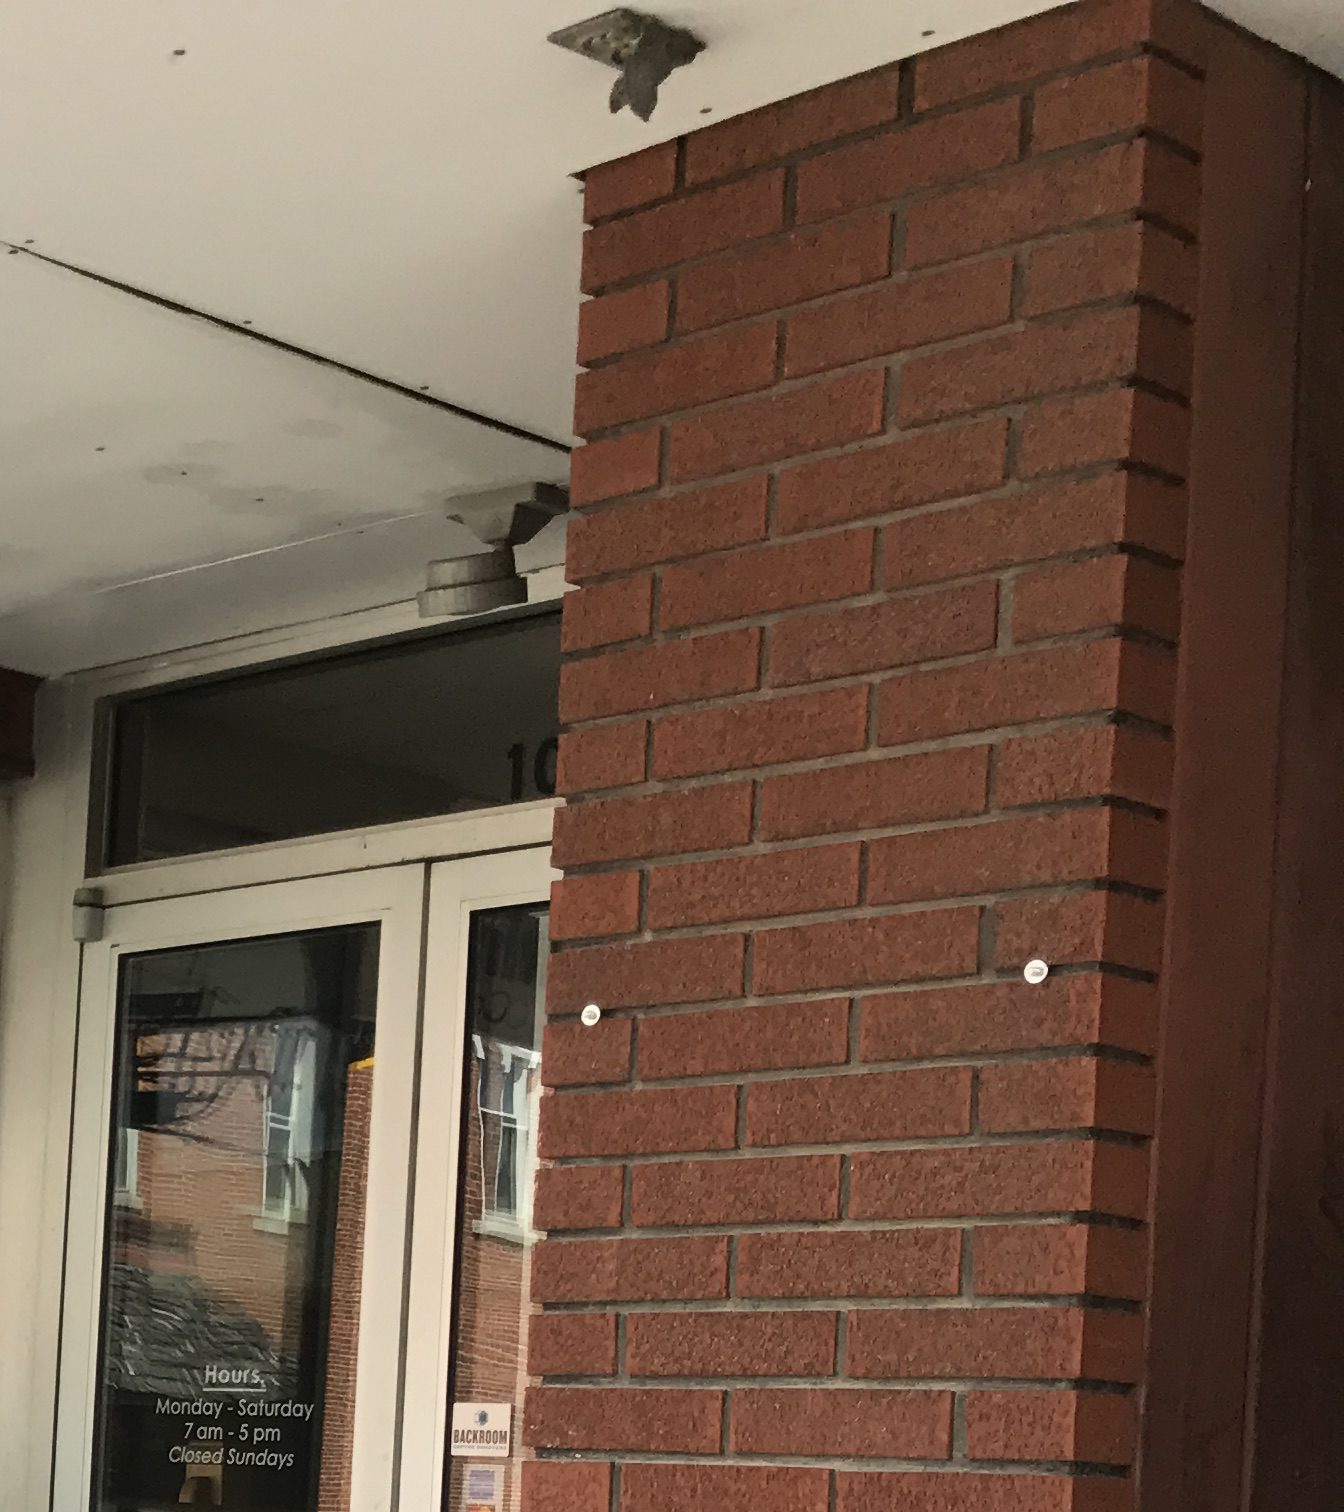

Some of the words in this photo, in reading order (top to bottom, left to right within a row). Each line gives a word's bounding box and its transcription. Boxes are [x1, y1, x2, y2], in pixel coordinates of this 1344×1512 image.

[155, 1398, 223, 1419] Monday
[238, 1399, 314, 1421] Saturday
[184, 1423, 194, 1438] 7
[197, 1426, 223, 1440] am
[239, 1423, 248, 1441] 5
[253, 1427, 281, 1445] pm
[454, 1430, 507, 1444] BACKROOM
[169, 1446, 224, 1463] Closed
[227, 1448, 294, 1470] Sundays
